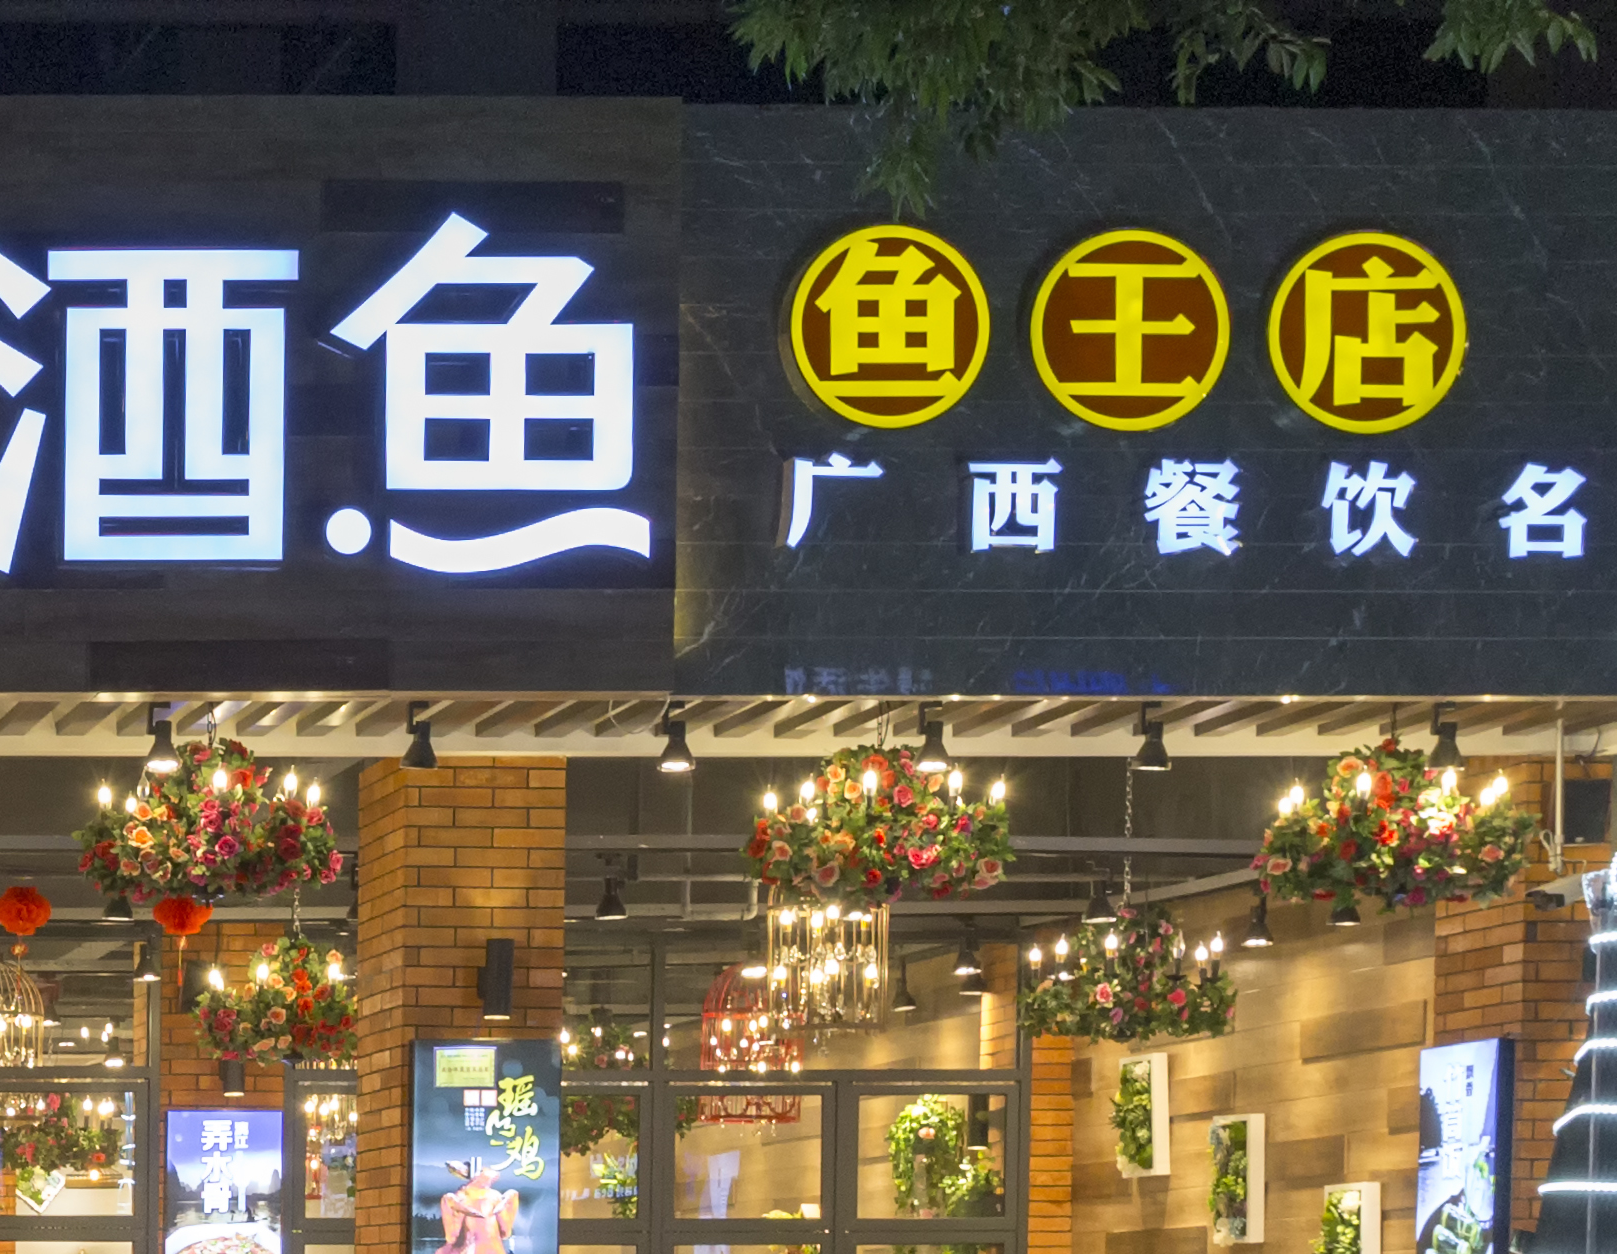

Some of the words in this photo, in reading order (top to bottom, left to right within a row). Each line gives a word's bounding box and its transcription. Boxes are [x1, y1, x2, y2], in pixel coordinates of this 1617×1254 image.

[815, 238, 1445, 408] 鱼王店
[785, 451, 1588, 560] 广西餐饮名
